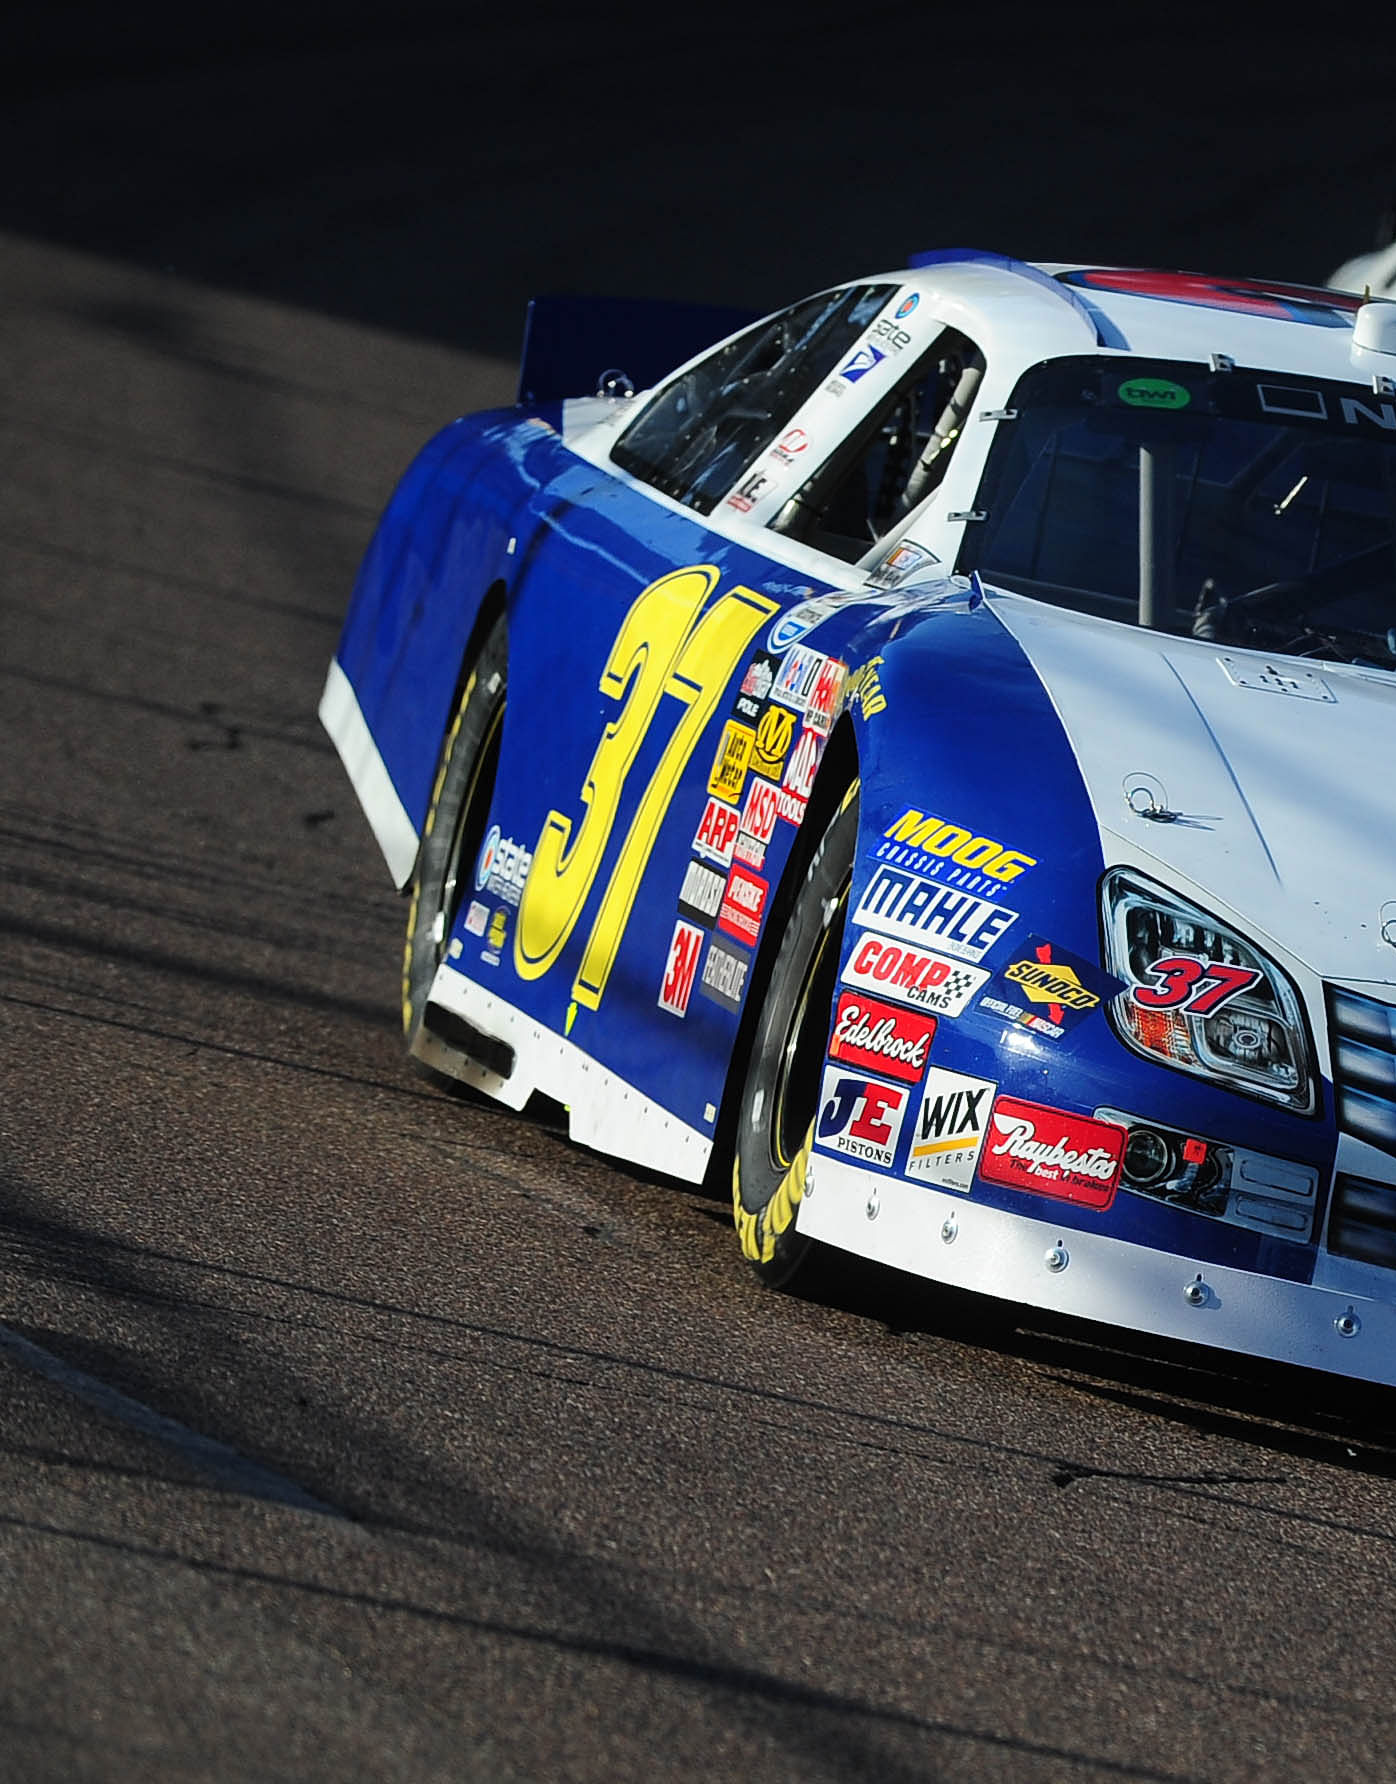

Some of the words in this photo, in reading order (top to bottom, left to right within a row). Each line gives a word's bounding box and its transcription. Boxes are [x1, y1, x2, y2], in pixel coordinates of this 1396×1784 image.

[736, 698, 760, 717] POLE
[514, 563, 781, 1011] 37
[741, 779, 778, 839] MSD
[776, 793, 806, 823] TOOLS
[697, 801, 740, 854] ARP
[883, 808, 1038, 883] MOOG
[875, 841, 946, 877] CHASSIS
[946, 868, 1001, 897] PARTS
[861, 867, 1015, 951] MAHLE
[663, 927, 701, 1011] 3M
[853, 940, 952, 991] COMP
[1008, 963, 1097, 1007] SUNOCO
[1130, 955, 1264, 1019] 37
[906, 985, 953, 1010] CAMS
[836, 1004, 931, 1069] Edelbrock
[818, 1078, 904, 1146] JE
[920, 1087, 987, 1140] WIX
[837, 1136, 893, 1164] PISTONS
[908, 1150, 975, 1171] FILTERS
[991, 1112, 1118, 1180] Raybestos
[1034, 1164, 1060, 1181] best
